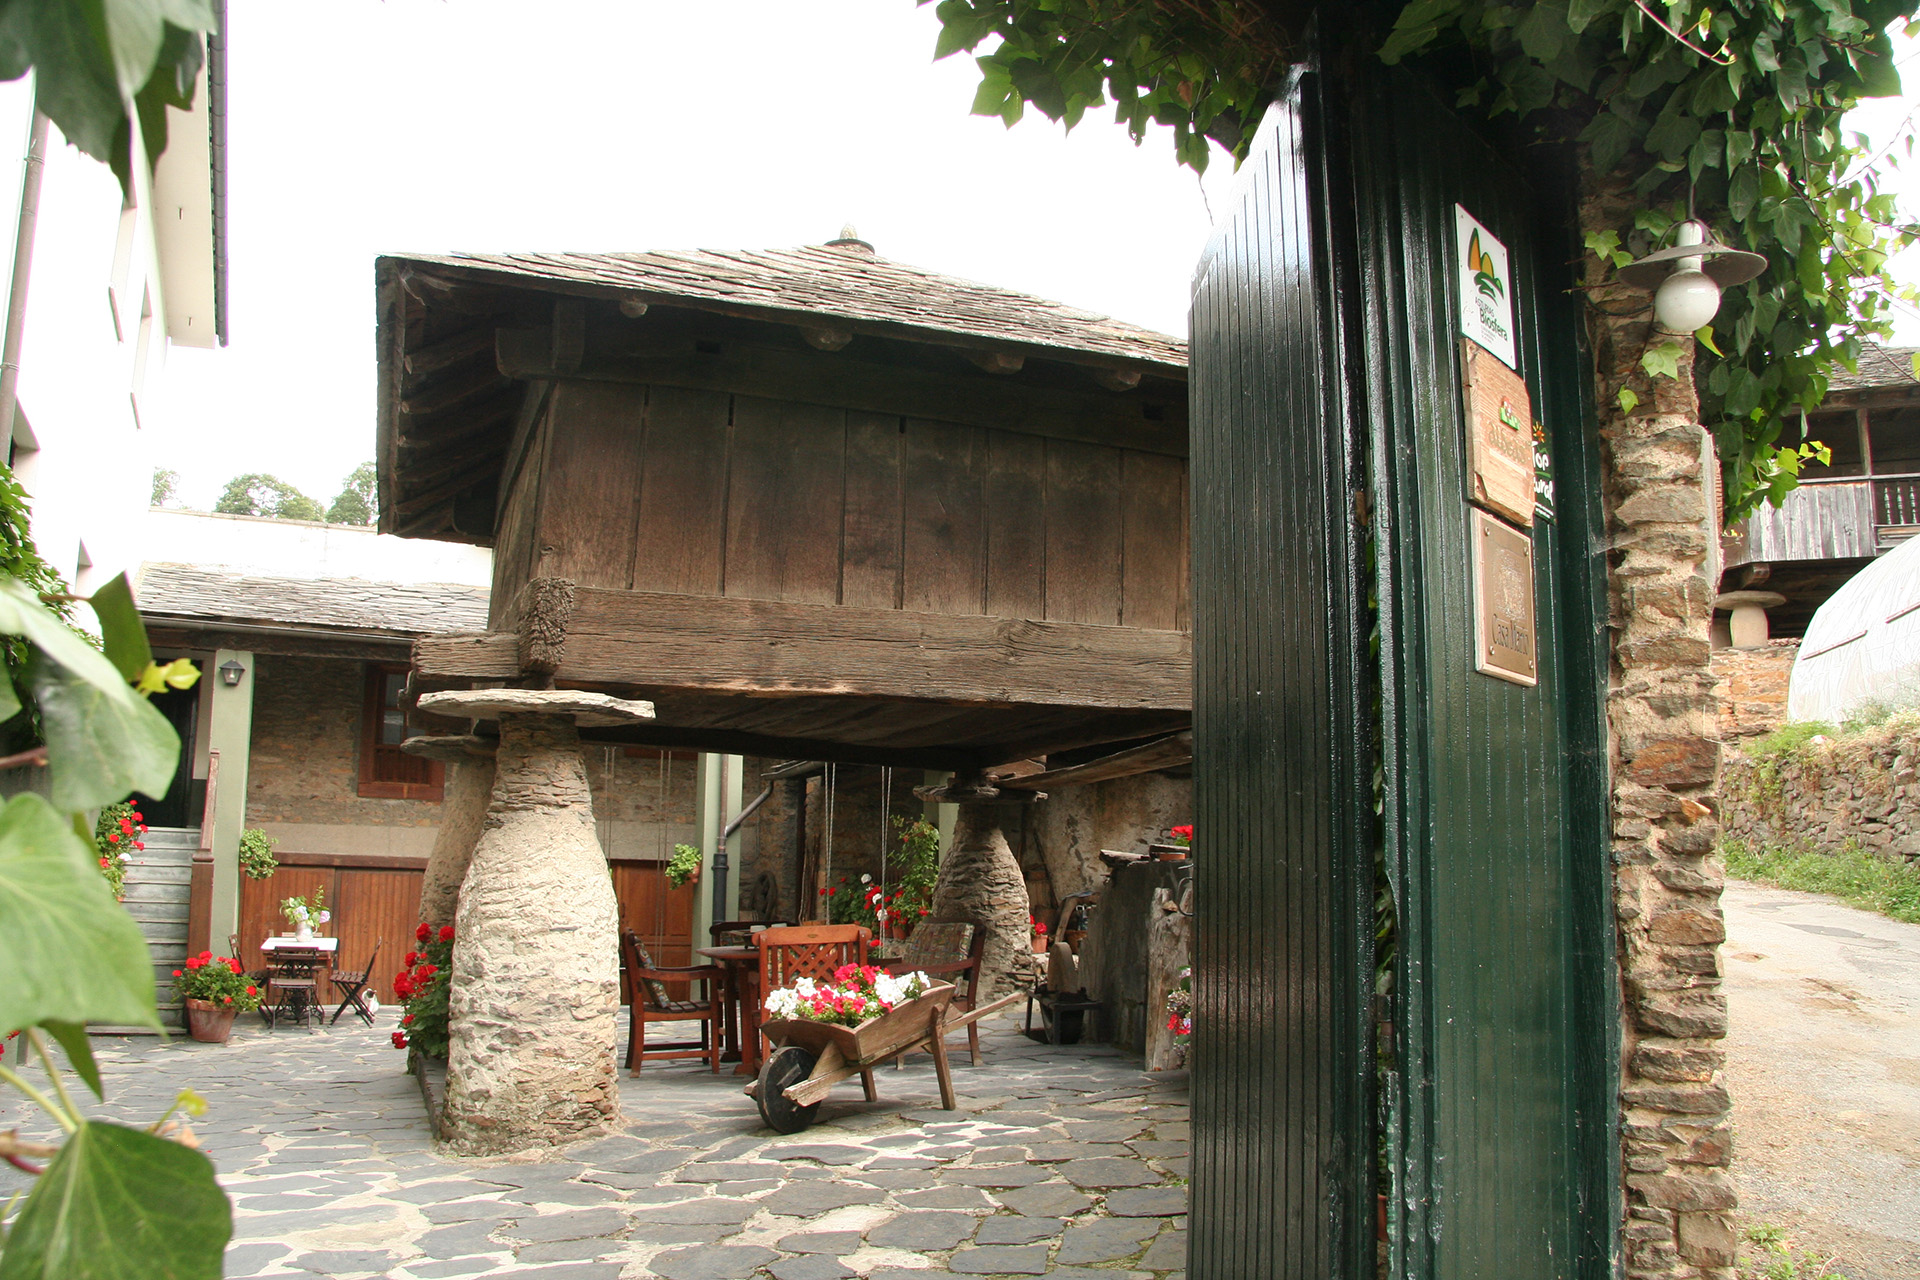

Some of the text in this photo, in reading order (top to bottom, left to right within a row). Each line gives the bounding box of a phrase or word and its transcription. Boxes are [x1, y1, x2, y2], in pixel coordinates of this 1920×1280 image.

[1480, 307, 1508, 341] Biosfera
[1531, 441, 1551, 471] Top
[1492, 613, 1508, 647] Casa
